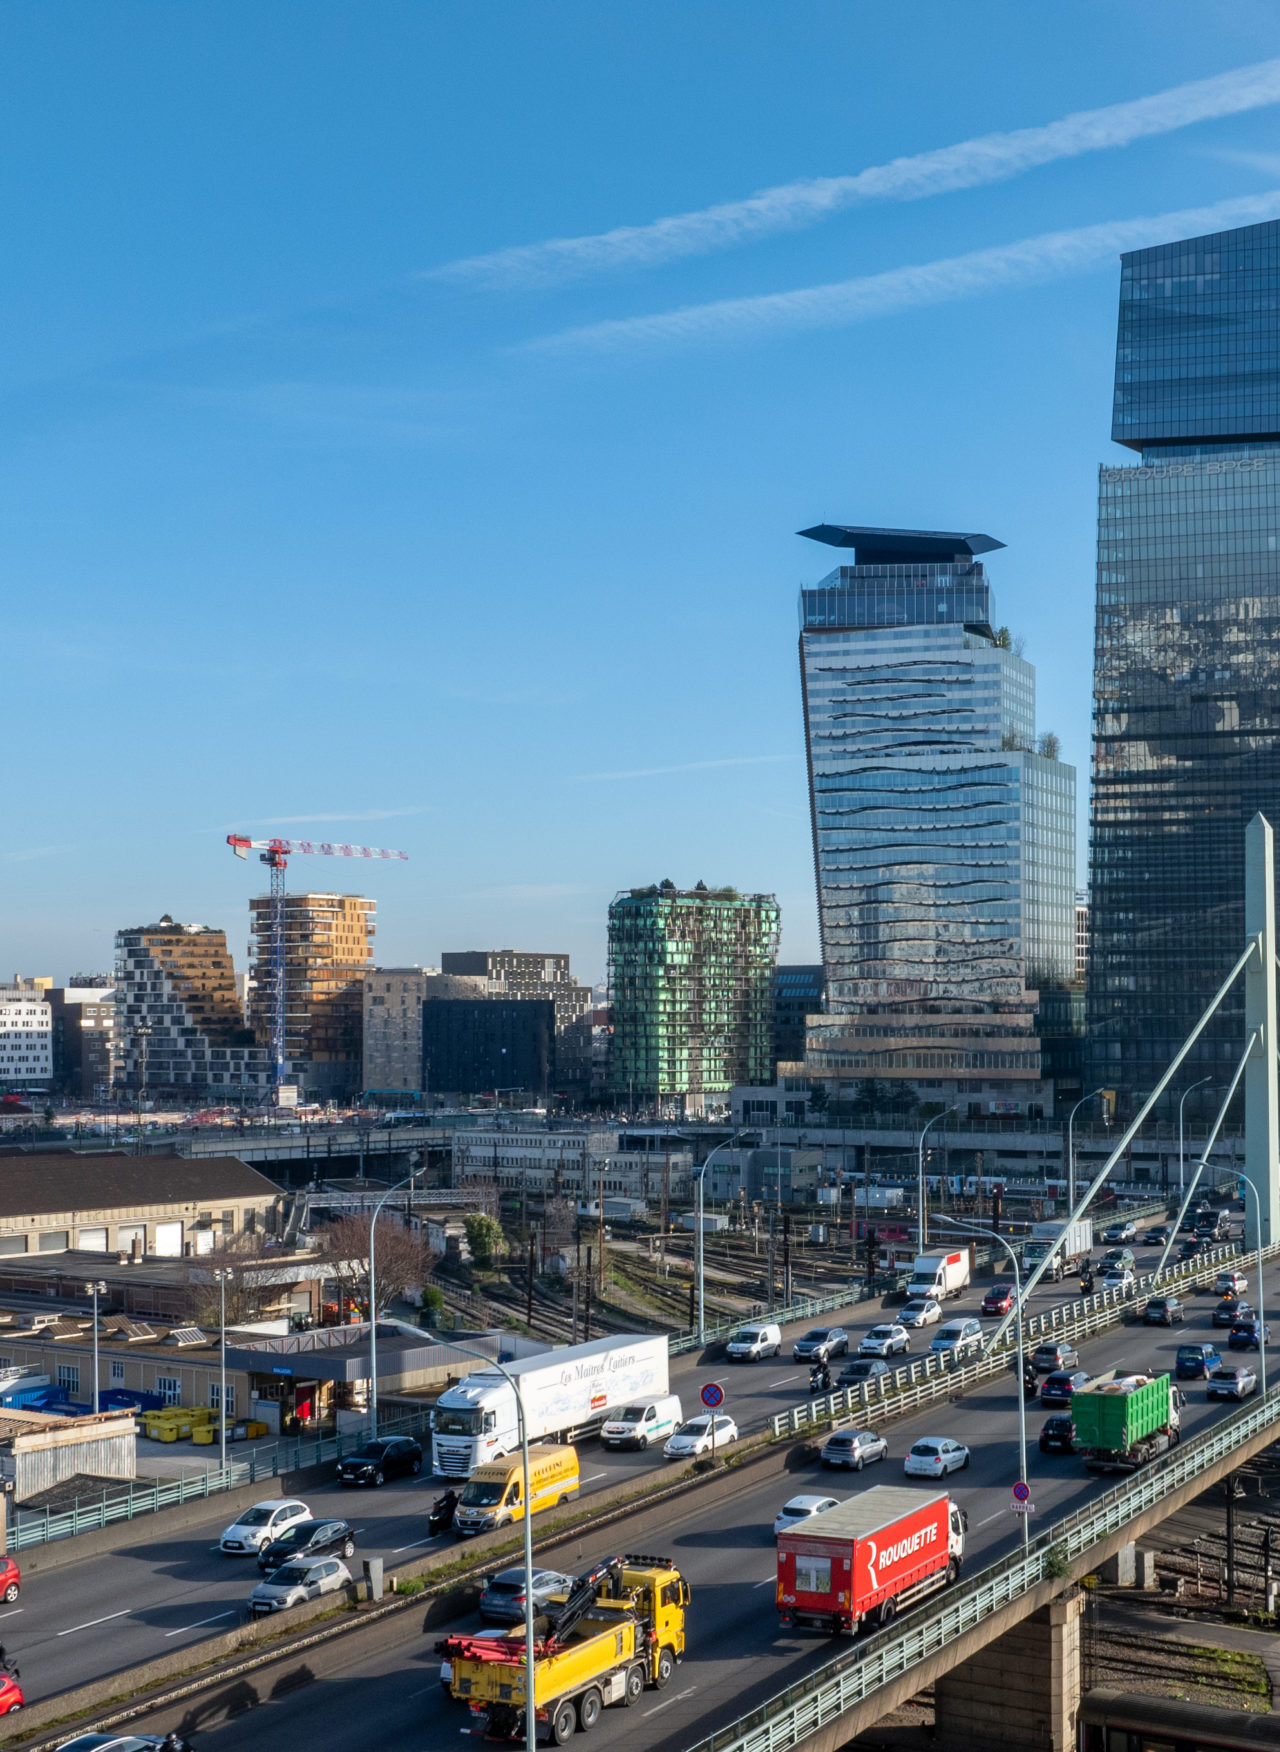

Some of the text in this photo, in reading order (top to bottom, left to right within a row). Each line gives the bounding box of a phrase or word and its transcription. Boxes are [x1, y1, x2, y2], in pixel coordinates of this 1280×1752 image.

[560, 1370, 572, 1386] Les
[607, 1354, 636, 1373] Laitiers
[879, 1522, 938, 1570] ROUQUETTE
